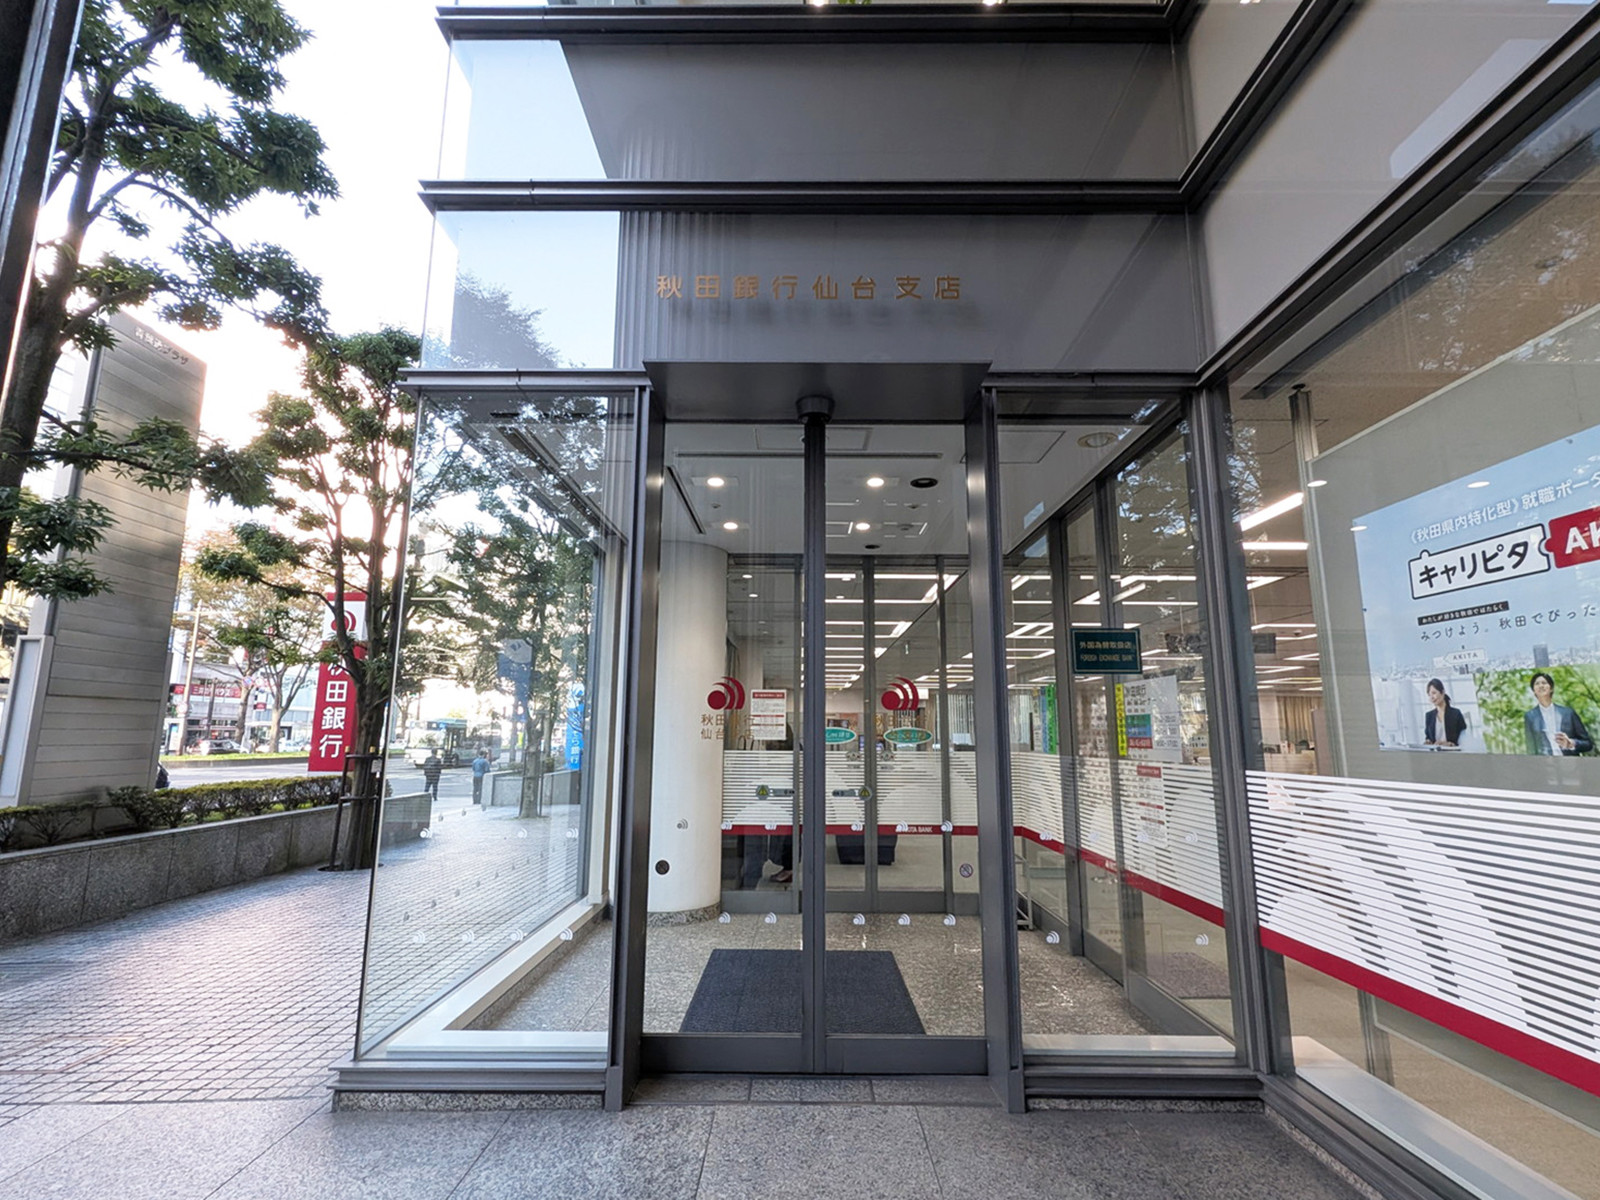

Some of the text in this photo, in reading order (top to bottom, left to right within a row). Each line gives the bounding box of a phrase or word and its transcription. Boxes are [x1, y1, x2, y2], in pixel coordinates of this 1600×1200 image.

[656, 274, 961, 300] 秋田銀行仙台支店
[1419, 541, 1528, 588] キャリピタ
[1453, 652, 1478, 661] AKITA
